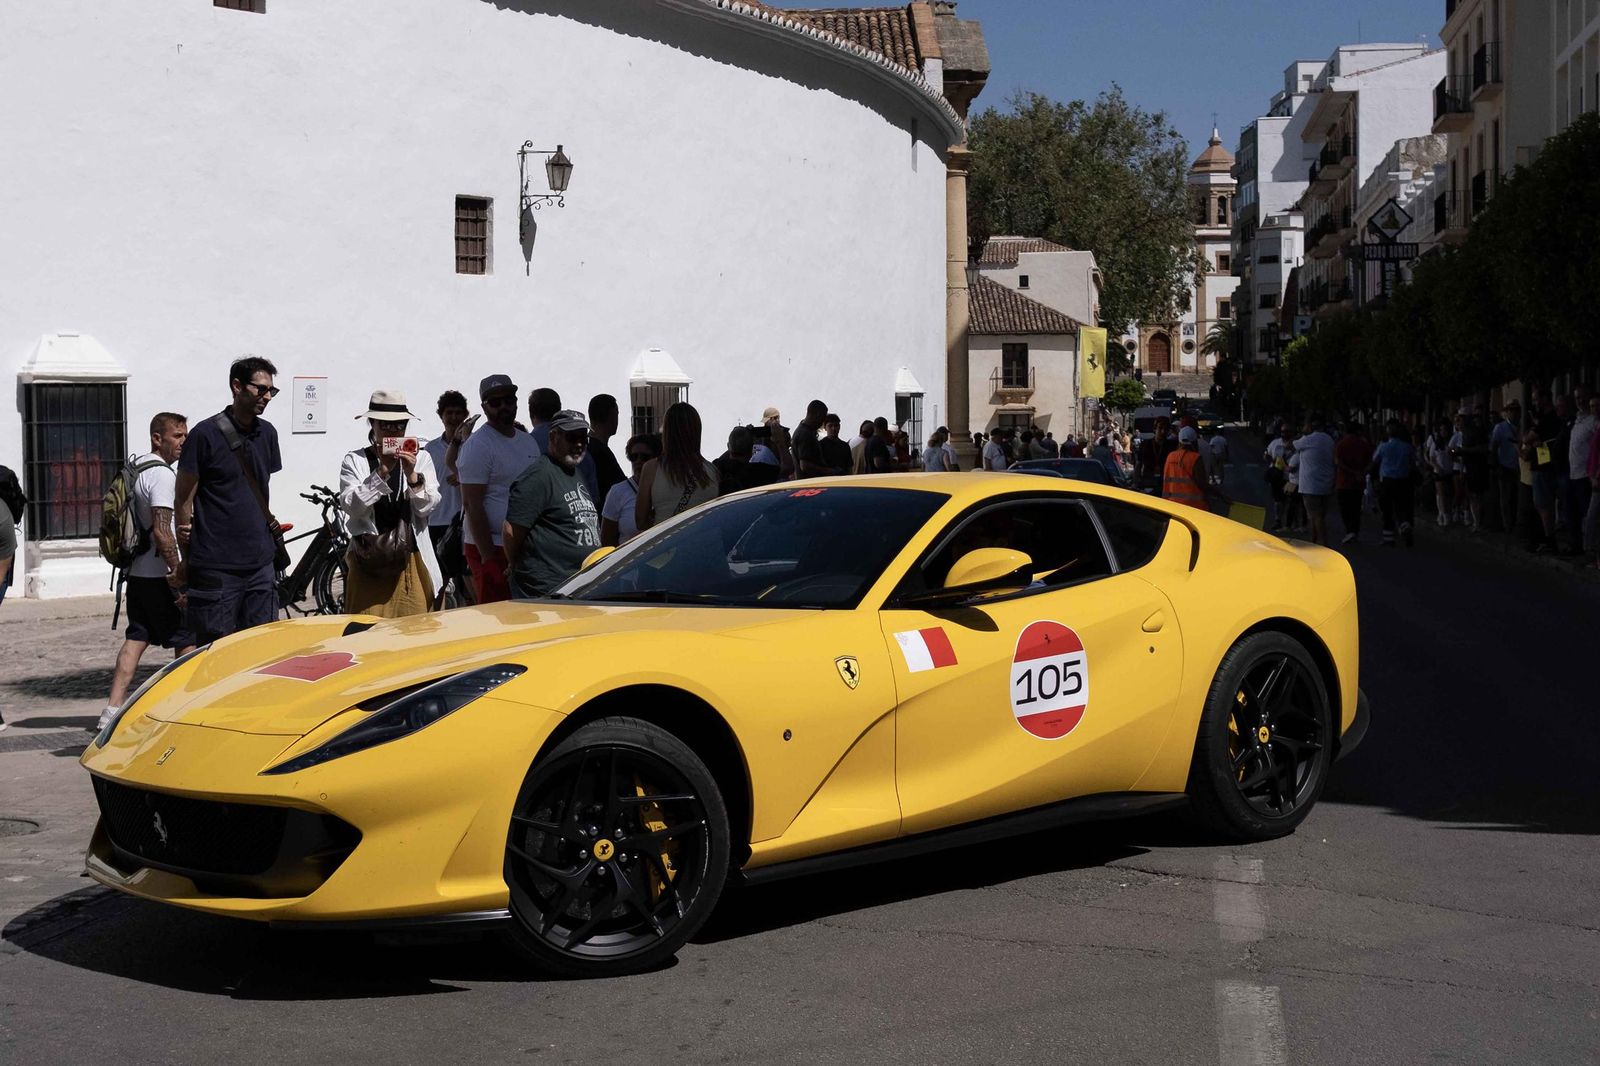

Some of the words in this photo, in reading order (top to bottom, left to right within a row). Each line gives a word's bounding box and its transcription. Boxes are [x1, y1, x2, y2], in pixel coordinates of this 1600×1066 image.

[1364, 244, 1387, 259] PEDRO
[1388, 244, 1417, 259] ROMERO
[574, 528, 593, 546] 78
[1016, 660, 1082, 705] 105
